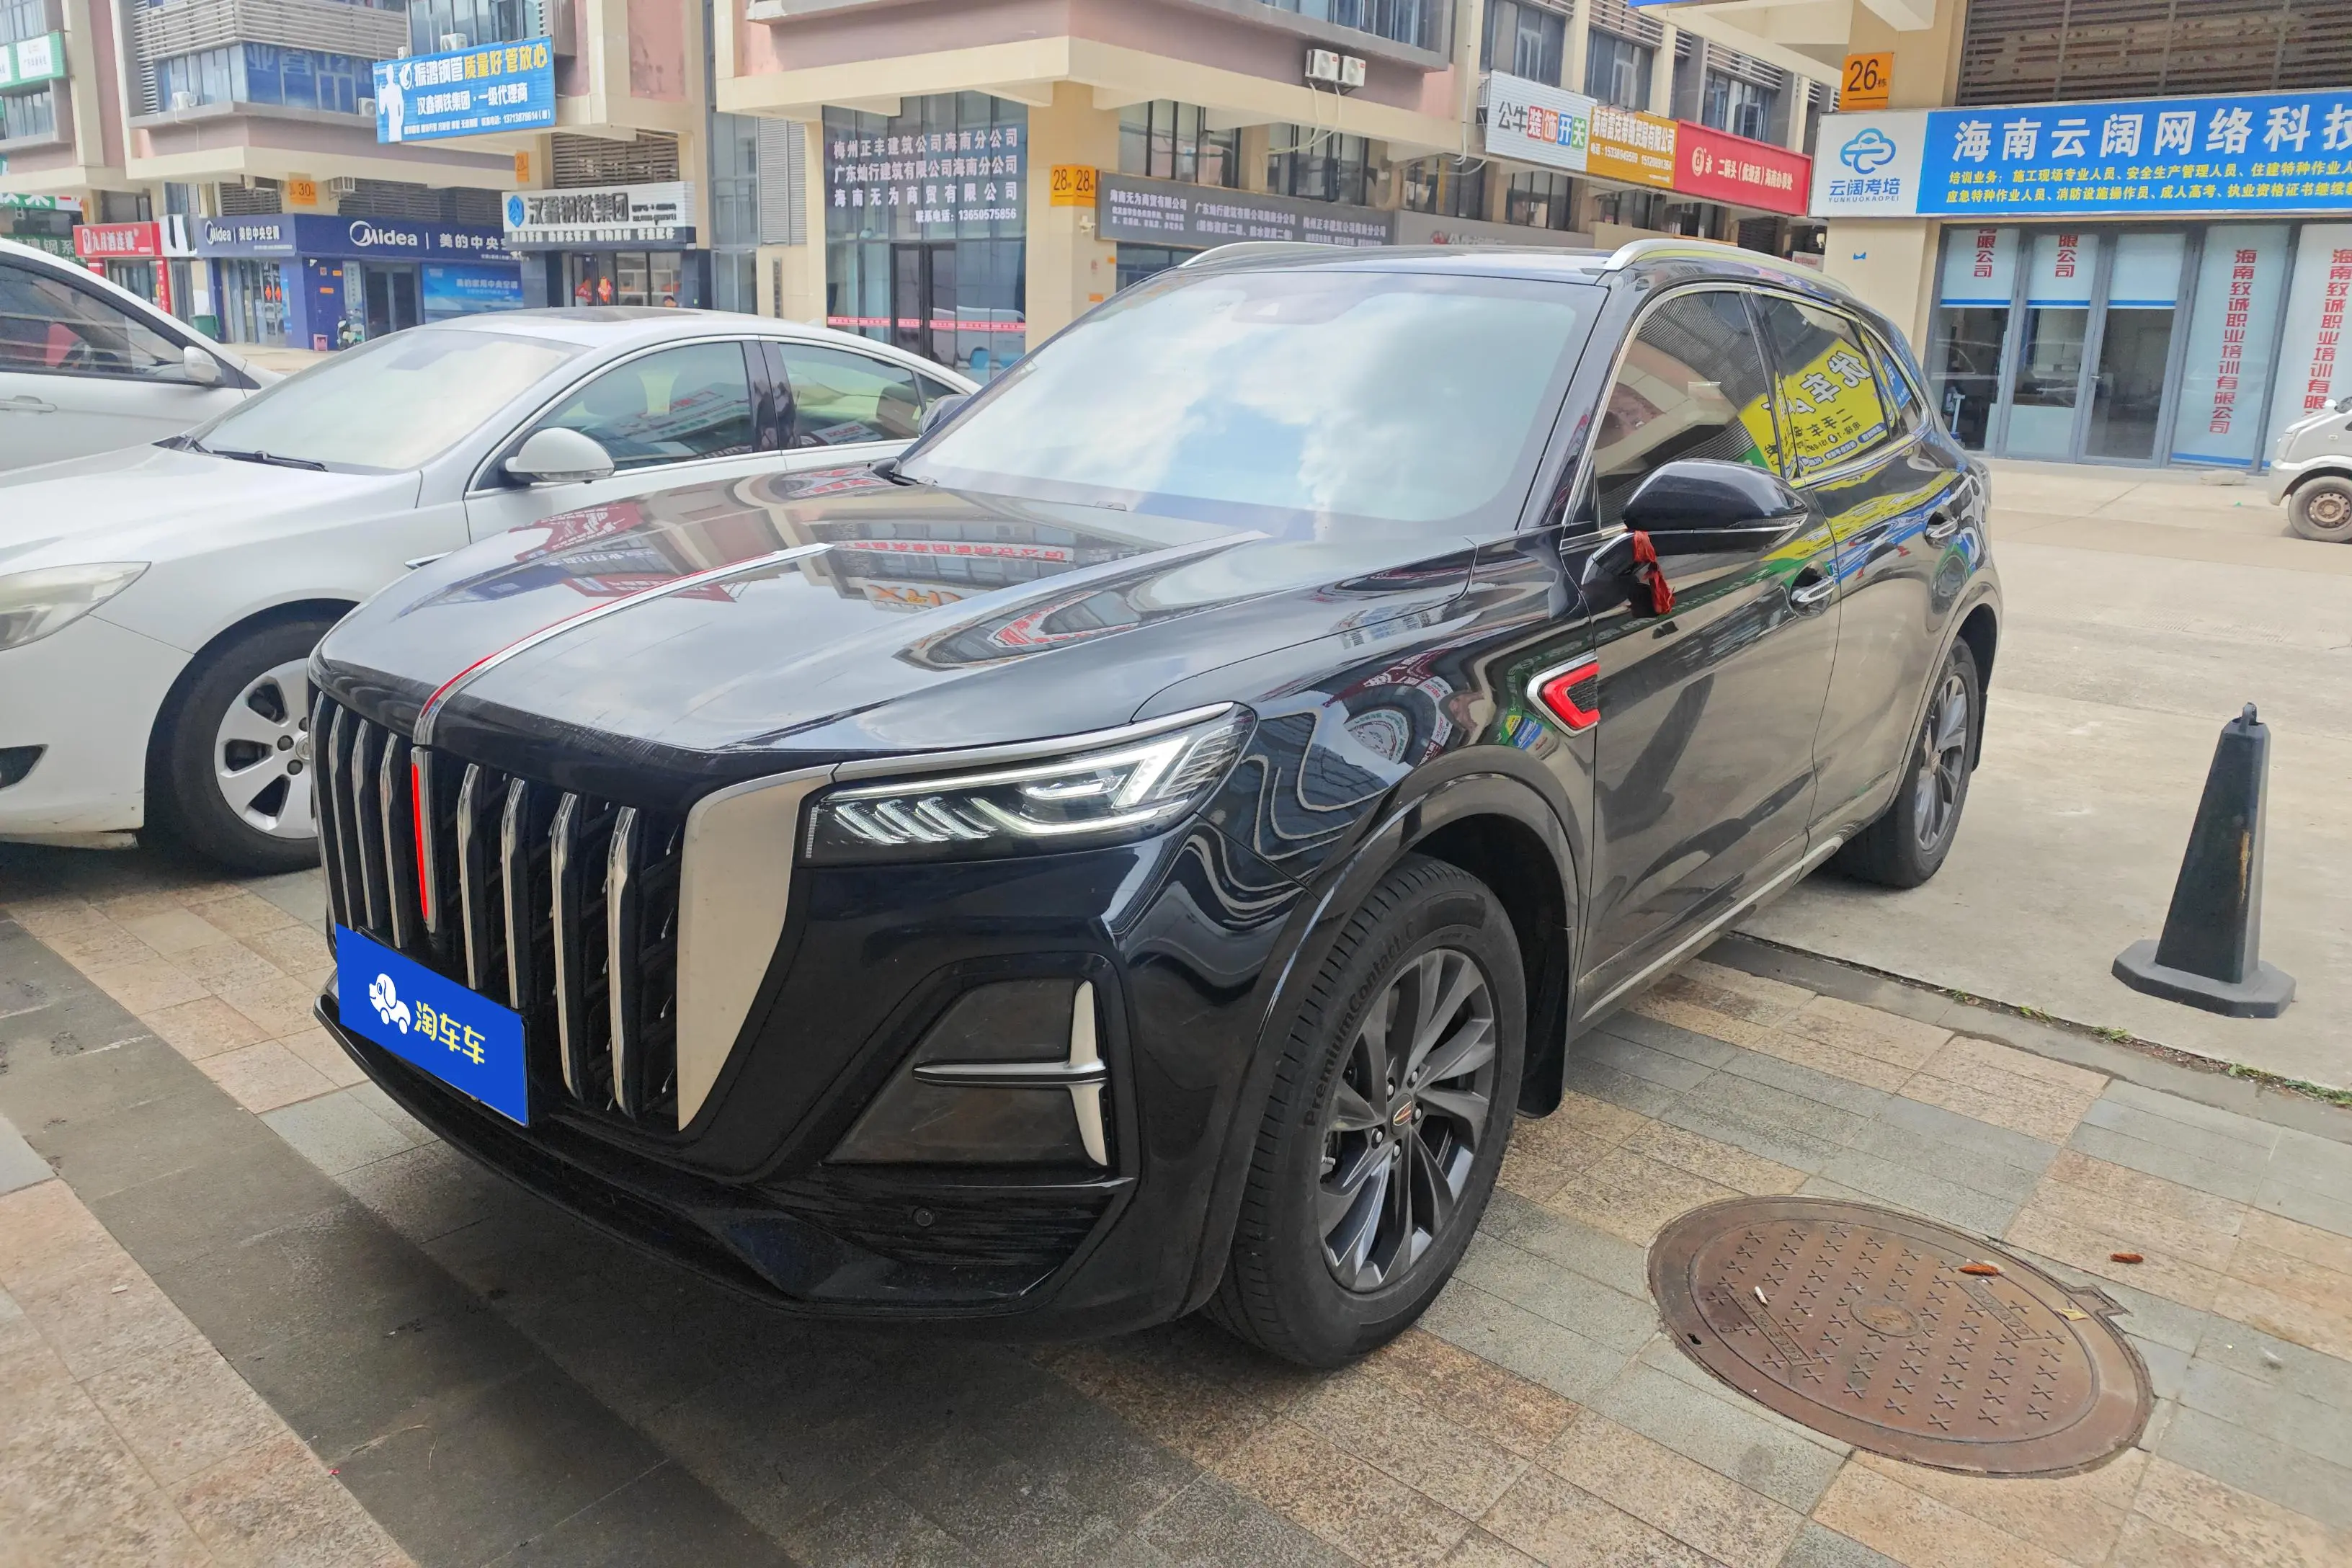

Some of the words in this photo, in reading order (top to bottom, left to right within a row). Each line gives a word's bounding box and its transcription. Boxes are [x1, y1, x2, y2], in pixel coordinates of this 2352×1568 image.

[207, 222, 231, 244] Midea
[1830, 177, 1901, 196] 云阔考培
[354, 223, 417, 246] Midea
[2209, 249, 2257, 435] 海南致诚职业培训有限公司
[2304, 248, 2352, 416] 海南致诚职业培训有限
[1303, 933, 1401, 1126] PremiumContact
